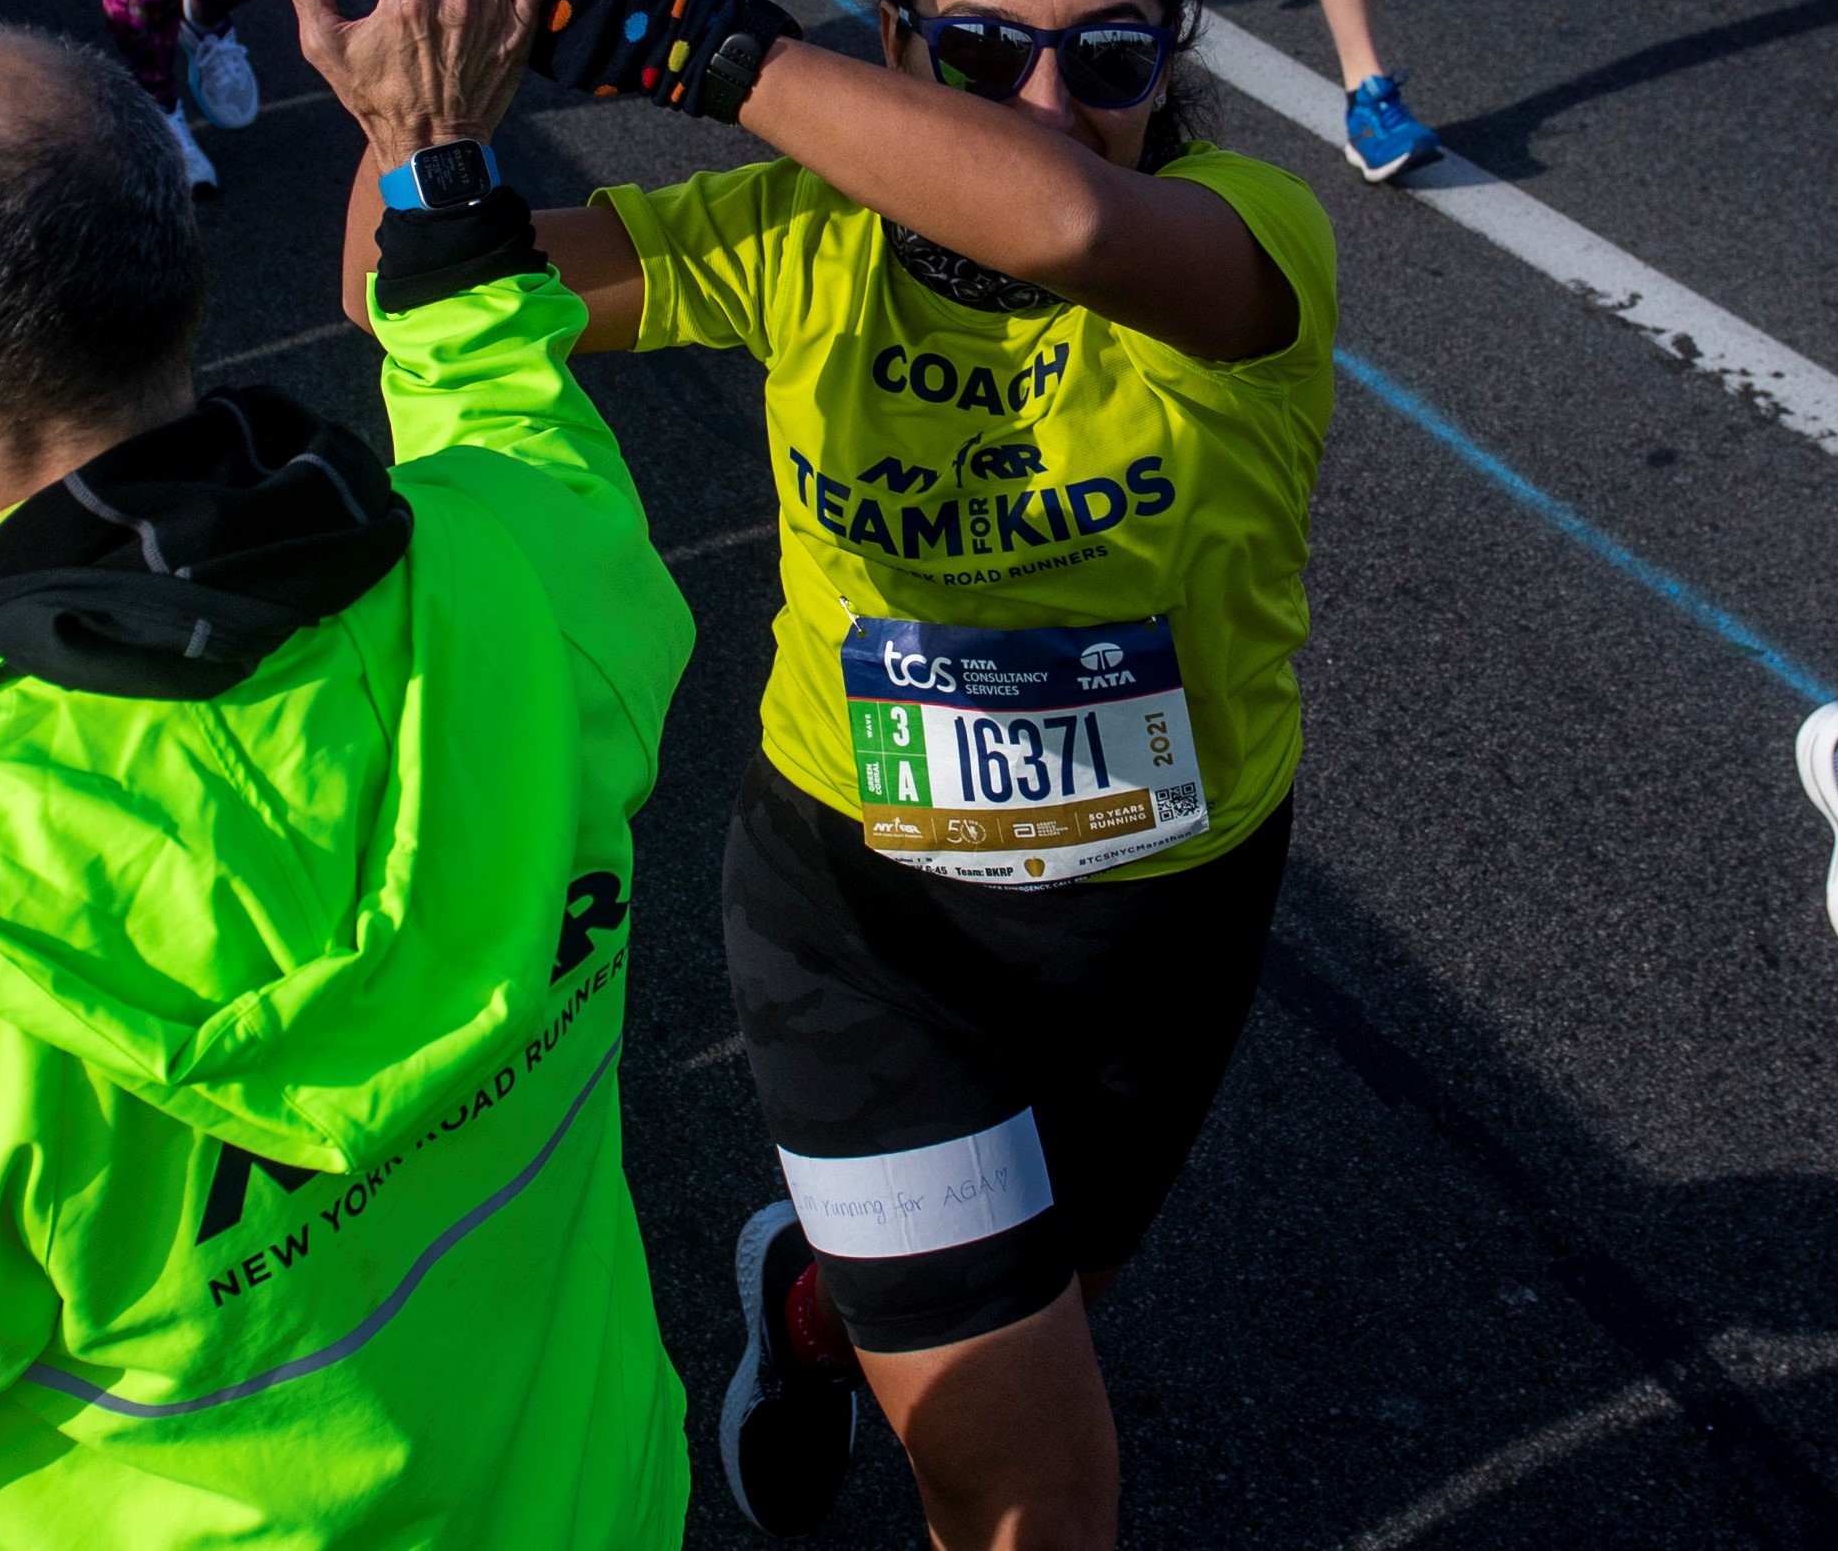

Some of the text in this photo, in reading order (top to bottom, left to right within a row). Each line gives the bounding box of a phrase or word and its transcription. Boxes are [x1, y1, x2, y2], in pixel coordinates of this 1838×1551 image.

[872, 342, 1070, 417] COACH
[789, 446, 1177, 560] TEAM FOR KIDS
[943, 568, 1002, 587] ROAD
[1008, 544, 1110, 579] RUNNERS
[883, 640, 957, 693] tcs
[960, 658, 998, 671] TATA
[962, 671, 1048, 684] CONSULTANCY
[1077, 670, 1137, 690] TATA
[965, 683, 1020, 696] SERVICES
[864, 713, 873, 739] WAVE
[890, 706, 910, 748] 3
[1144, 711, 1174, 768] 2021
[954, 711, 1111, 804] 16371
[865, 763, 875, 793] GREEN
[872, 761, 883, 796] CORRAL
[898, 760, 920, 803] A
[1089, 803, 1146, 822] 50 YEARS
[1089, 812, 1147, 831] RUNNING
[1079, 830, 1193, 866] #TCSNYCMarathon
[955, 867, 984, 877] Team:
[985, 867, 1014, 877] BKRP
[207, 1223, 311, 1308] NEW
[525, 941, 629, 1074] RUNNER
[821, 1198, 886, 1225] running
[895, 1191, 925, 1218] for
[943, 1175, 994, 1207] AGA
